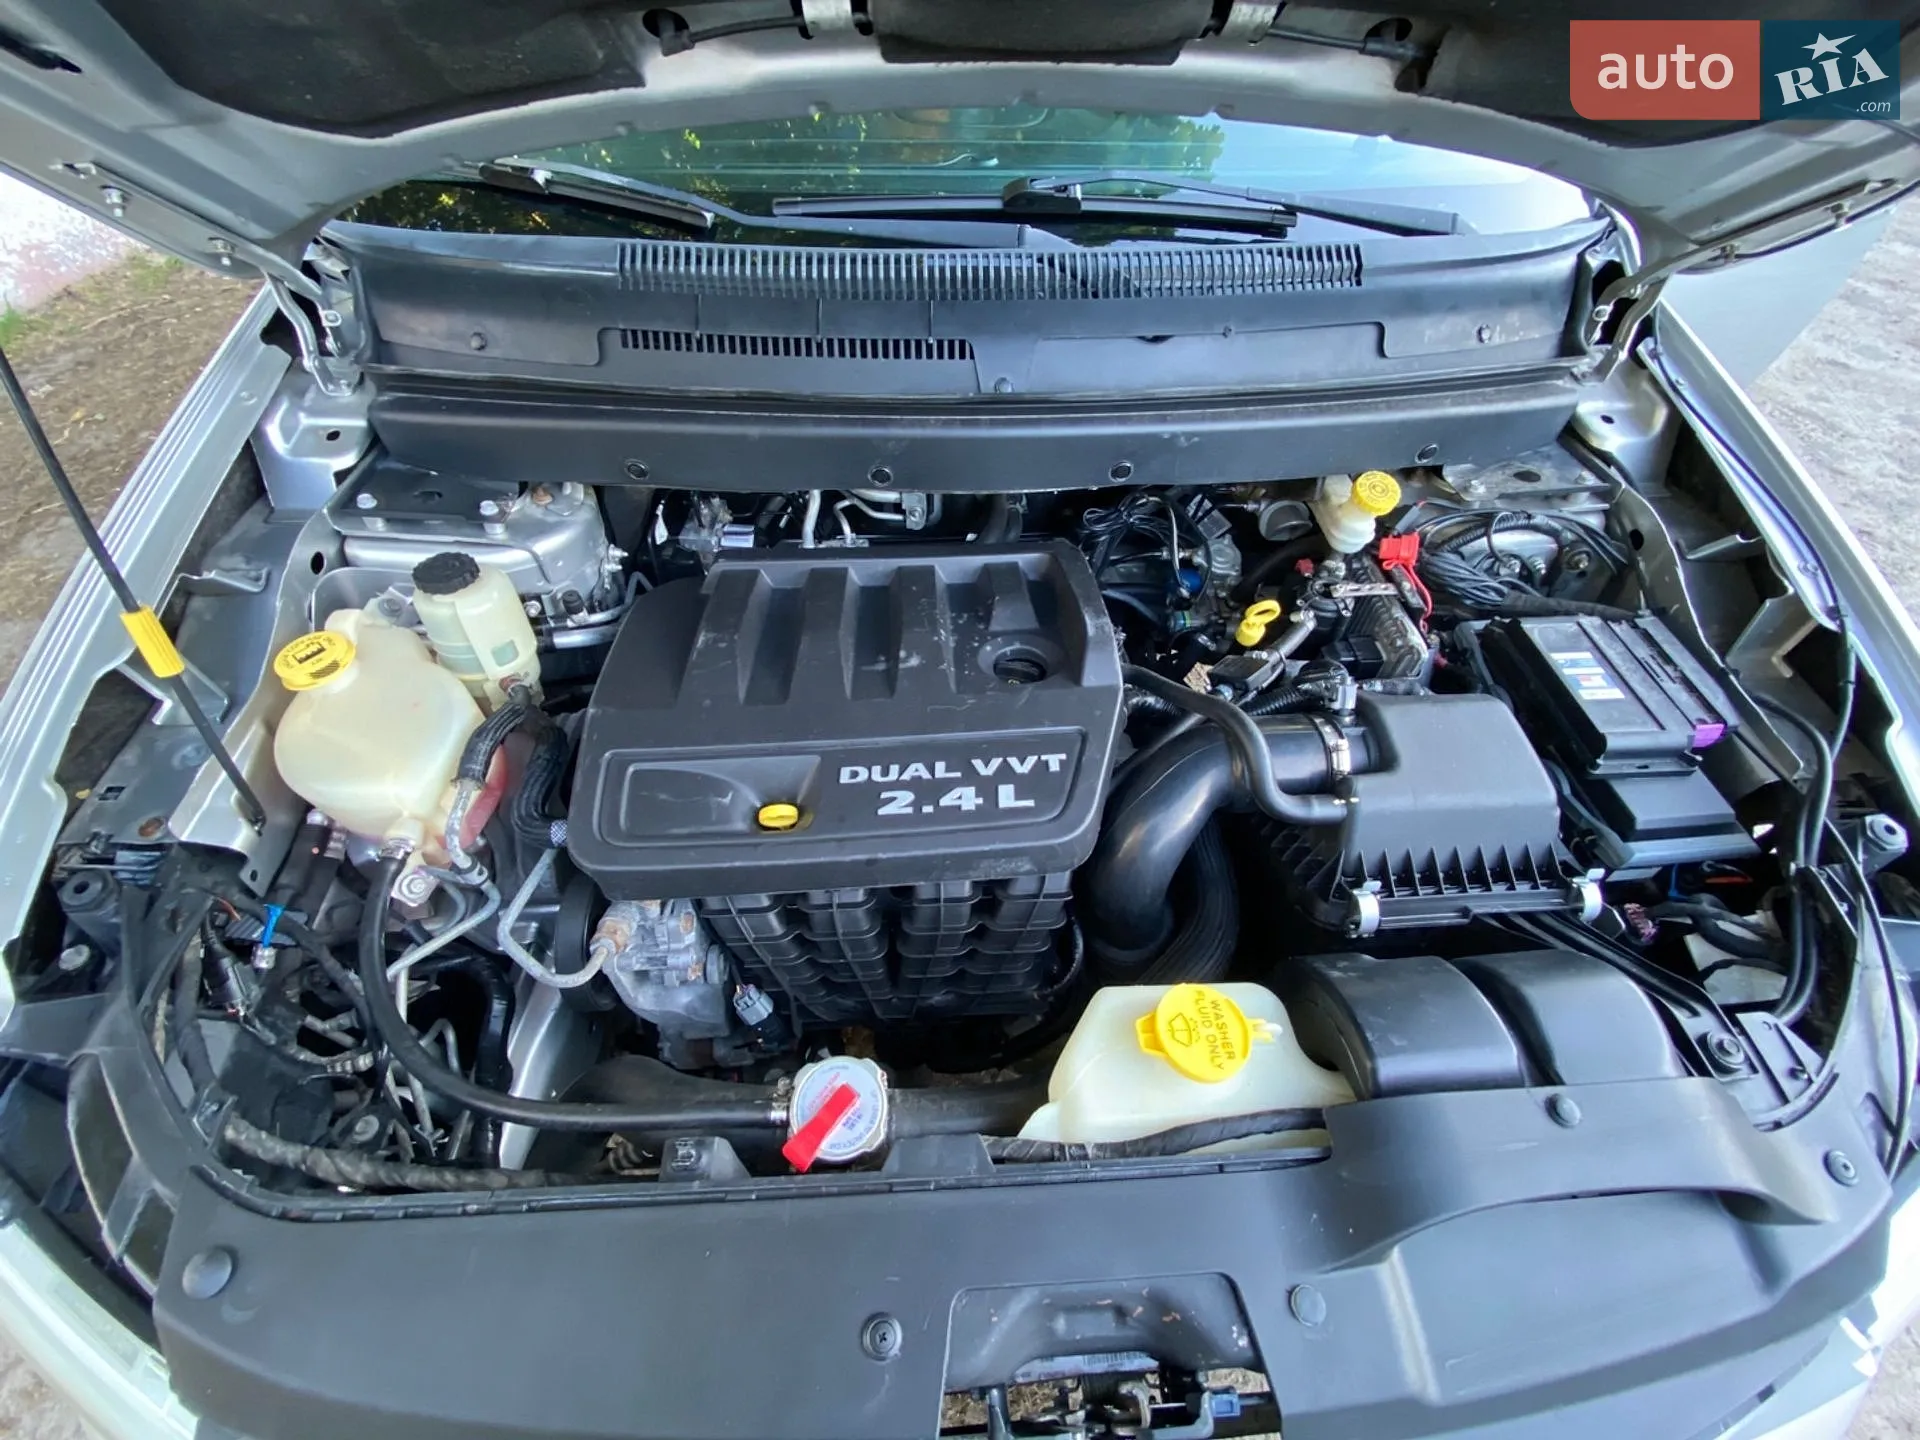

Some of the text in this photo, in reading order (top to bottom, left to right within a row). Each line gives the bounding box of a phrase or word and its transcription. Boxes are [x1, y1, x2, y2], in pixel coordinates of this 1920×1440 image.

[839, 753, 1067, 784] DUAL VVT
[1194, 989, 1225, 1071] FLUID ONLY
[1209, 999, 1236, 1061] WASHER
